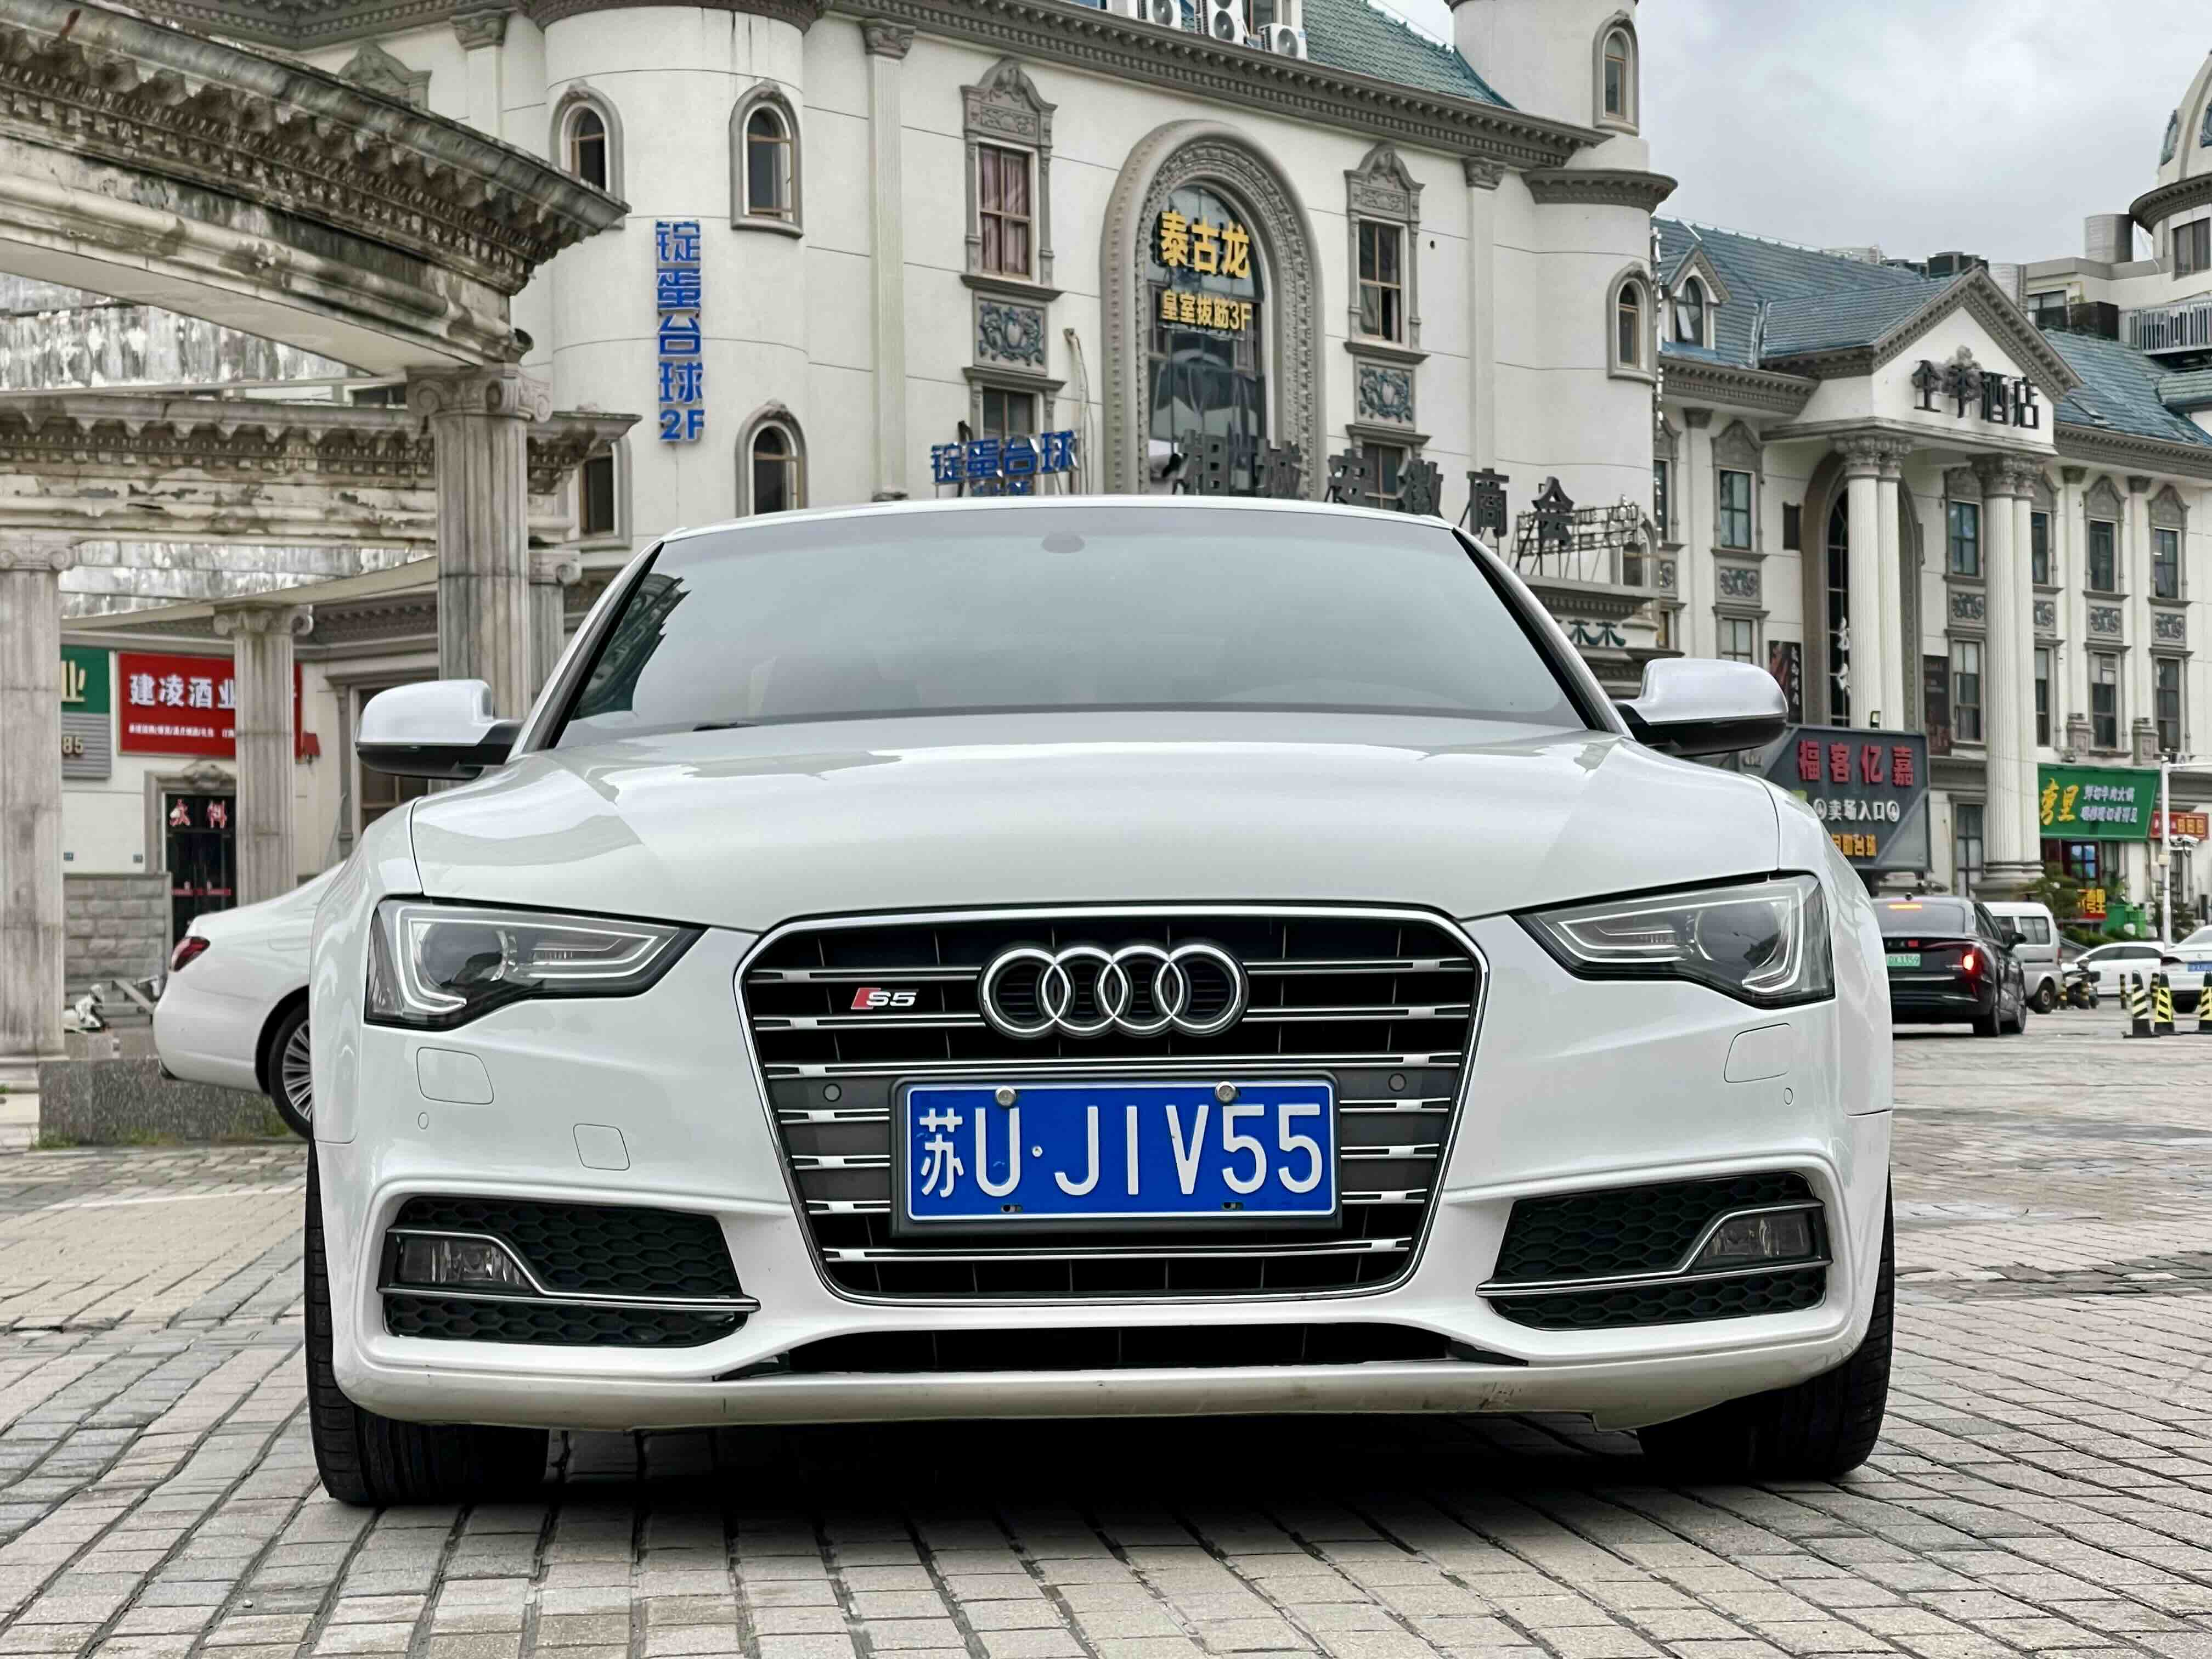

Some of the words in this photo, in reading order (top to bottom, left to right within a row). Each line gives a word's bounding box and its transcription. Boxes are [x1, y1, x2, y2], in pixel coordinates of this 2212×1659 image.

[659, 409, 704, 439] 2F
[1828, 799, 1886, 821] 卖场入口
[866, 991, 917, 1007] S5
